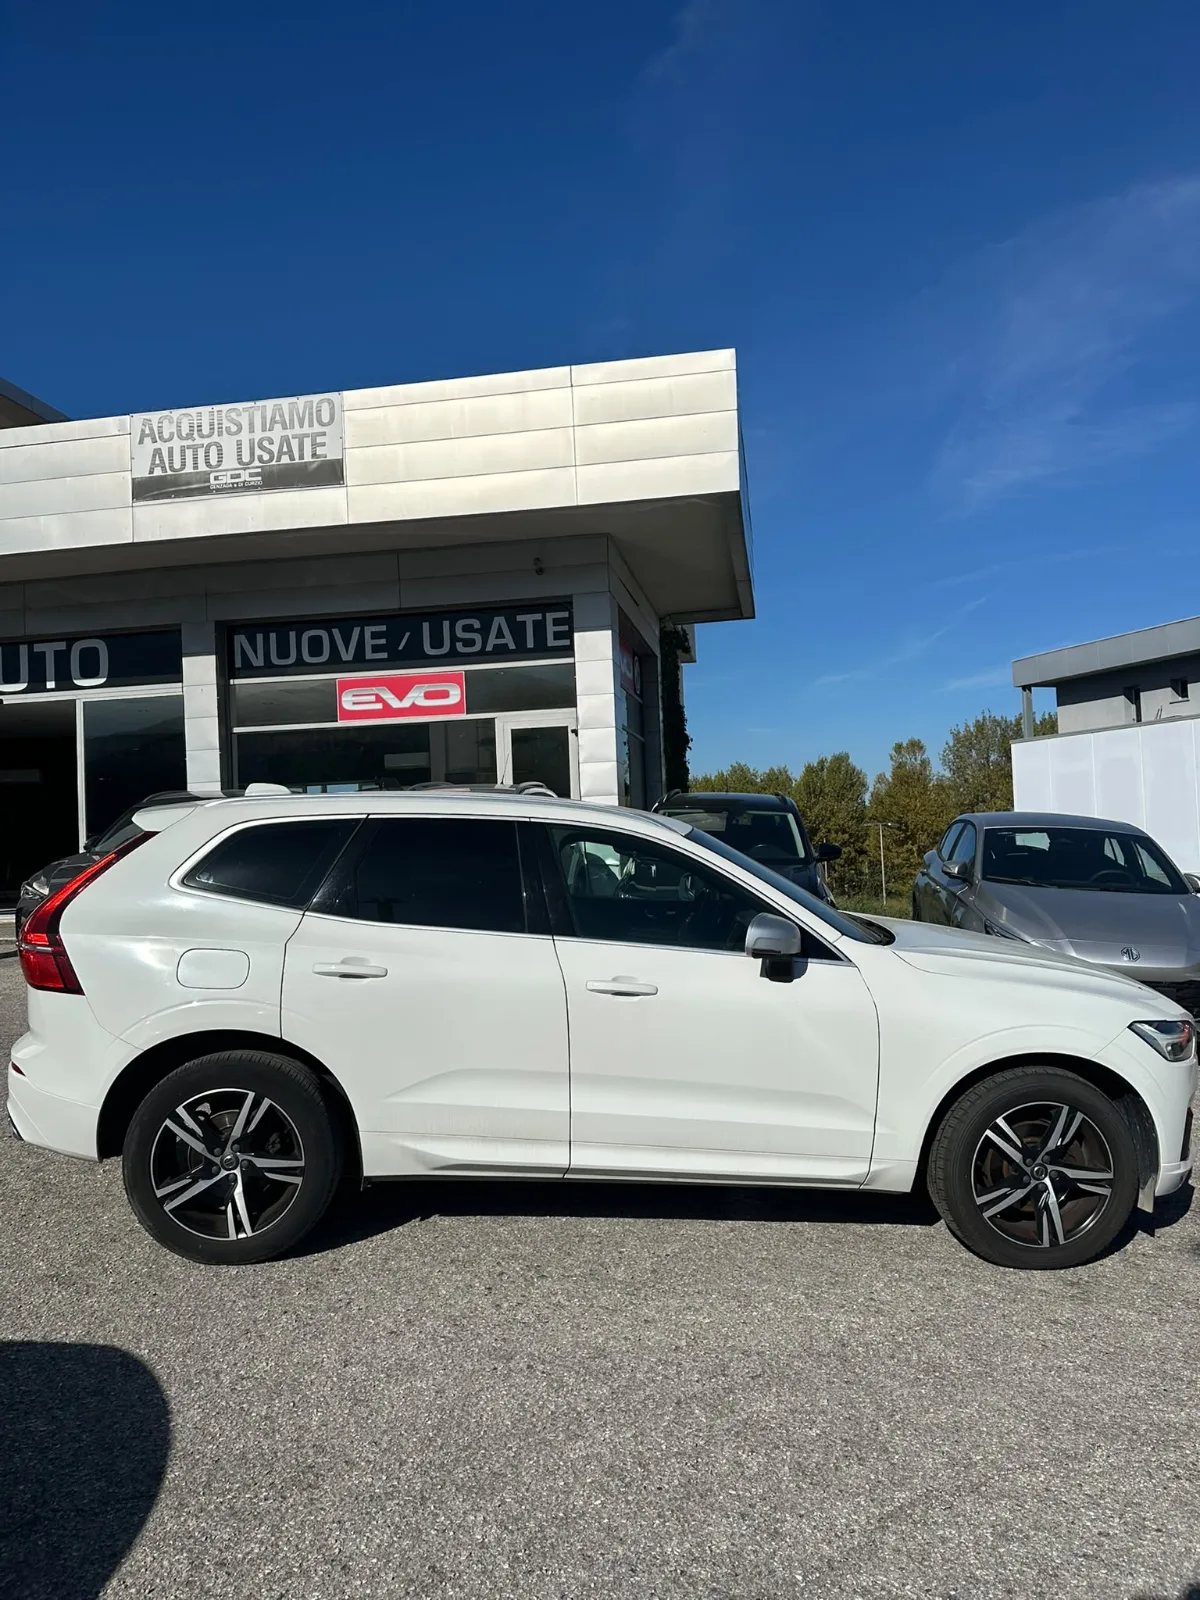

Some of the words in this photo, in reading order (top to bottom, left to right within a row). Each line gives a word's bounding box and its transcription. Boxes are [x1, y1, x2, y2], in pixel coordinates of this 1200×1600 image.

[138, 397, 336, 445] ACQUISTIAMO
[148, 441, 224, 475] AUTO
[236, 431, 328, 466] USATE
[210, 468, 262, 485] GDC
[234, 625, 388, 668] NUOVE
[422, 611, 571, 656] USATE
[0, 638, 109, 692] UTO
[341, 682, 461, 711] EVO
